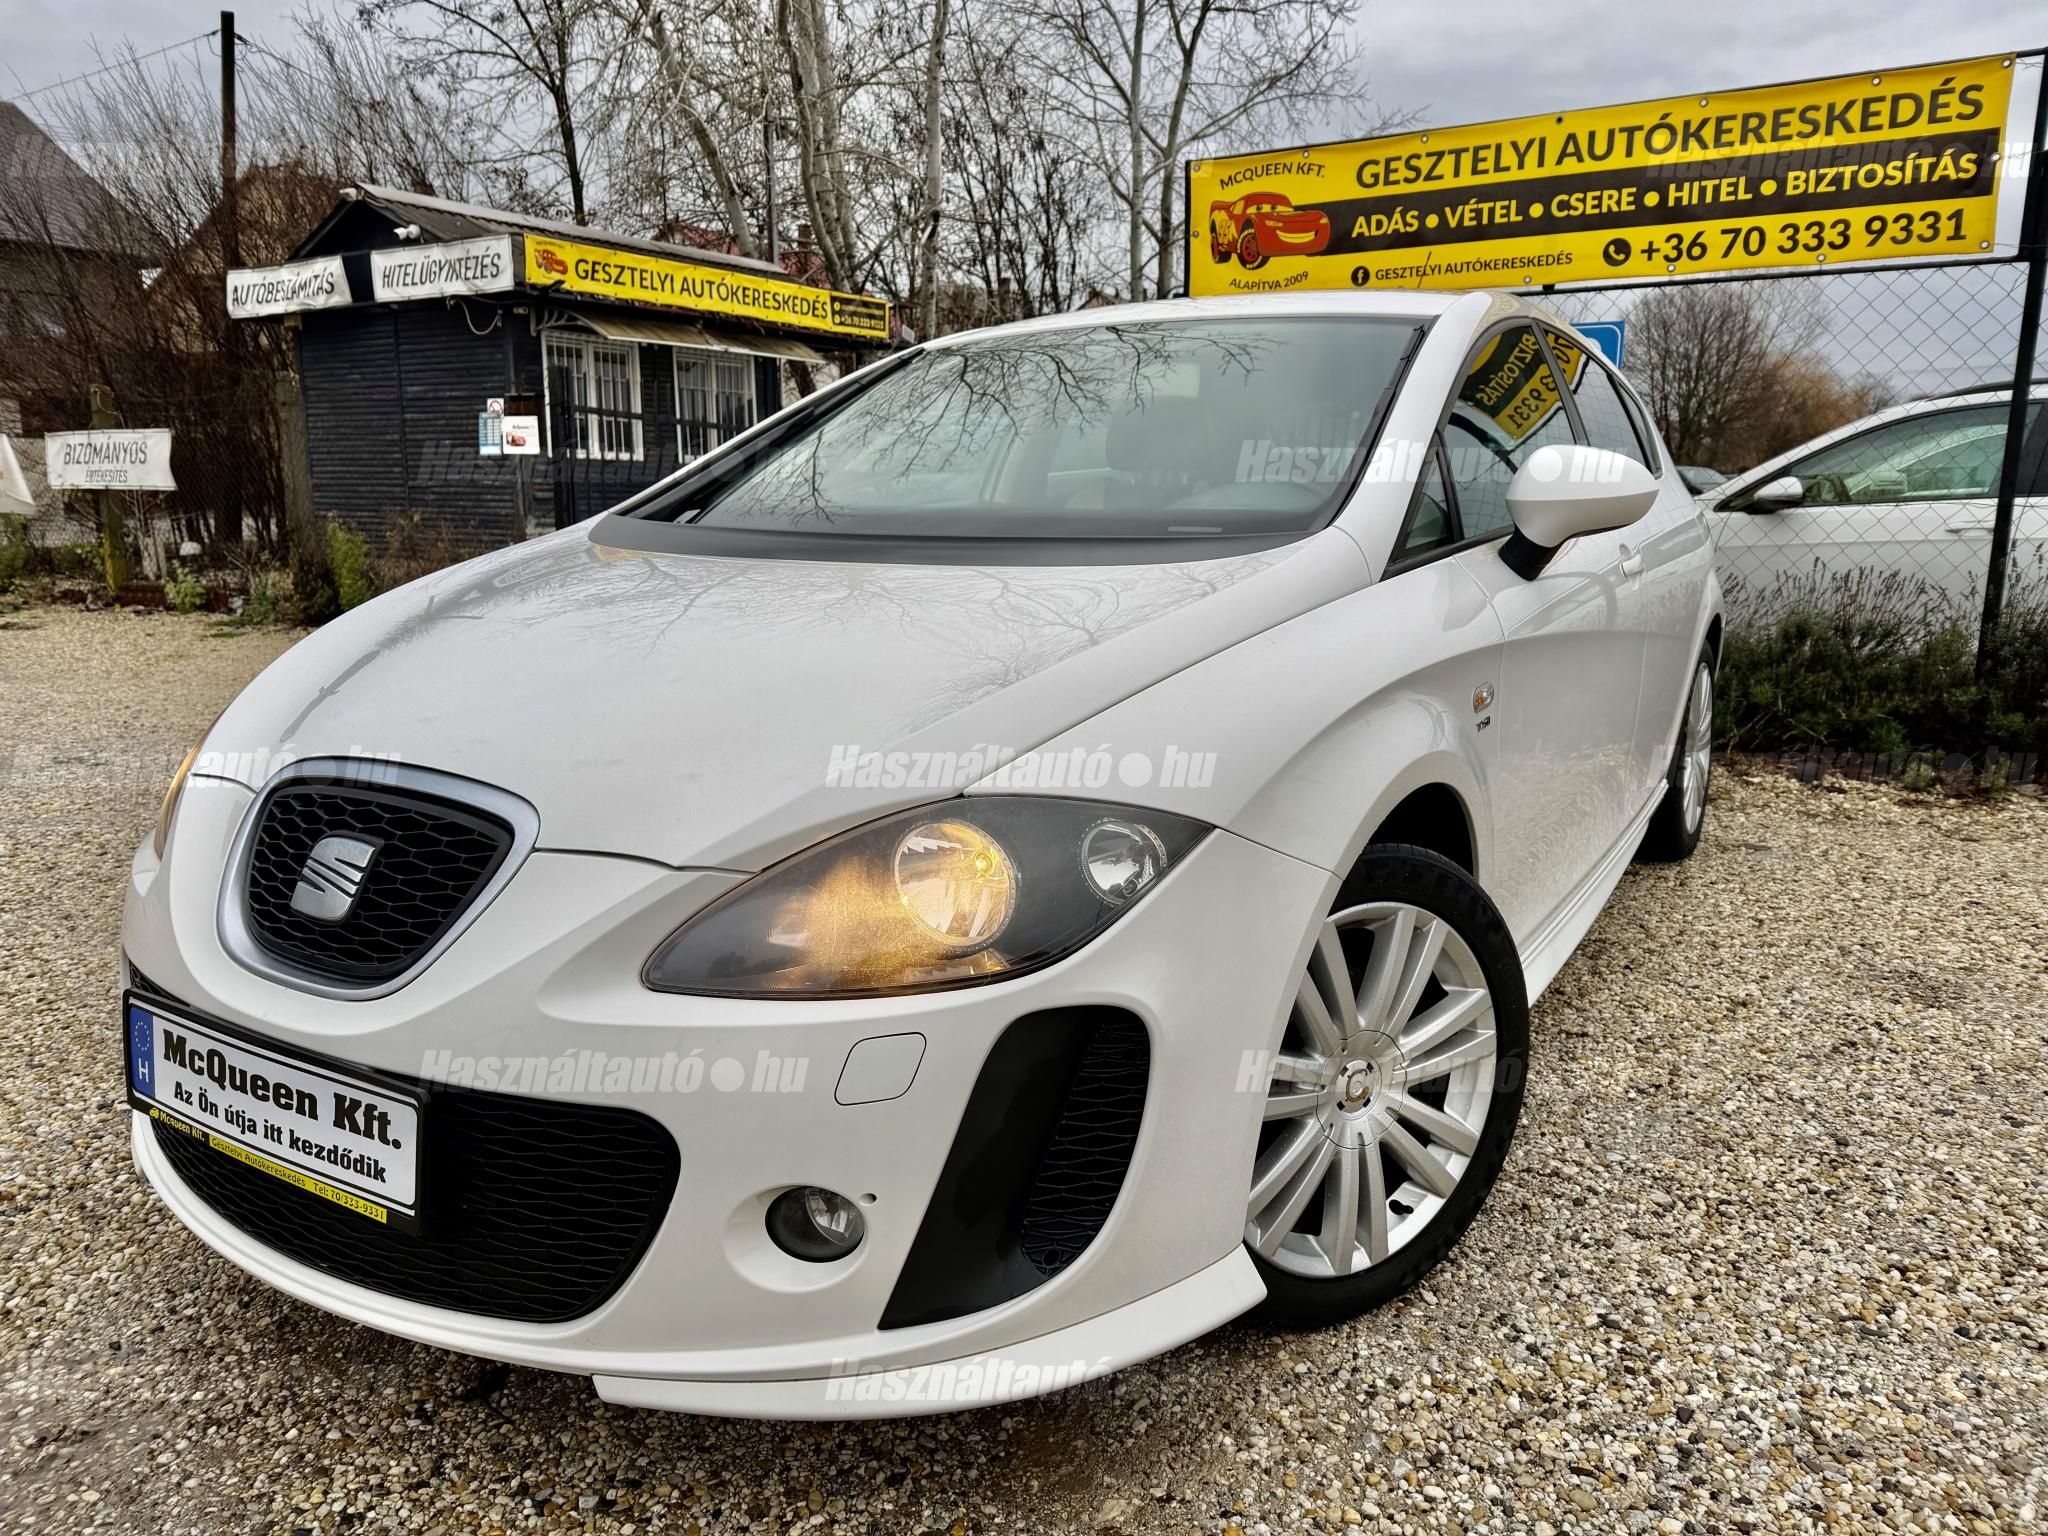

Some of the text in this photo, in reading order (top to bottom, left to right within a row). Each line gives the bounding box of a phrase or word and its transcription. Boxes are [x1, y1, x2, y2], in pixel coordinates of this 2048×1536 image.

[1356, 76, 1985, 189] GESZTELYI AUTÓKERESKEDÉS
[1219, 161, 1326, 191] MCQUEEN KFT.
[1351, 148, 1979, 239] ADÁS VÉTEL CSERE HITEL BIZTOSÍTÁS
[1639, 208, 1968, 263] +36 70 333 9331
[1229, 271, 1310, 291] ALAPÍTVA 2009
[1374, 250, 1574, 281] GESZTELYI AUTÓKERESKEDÉS
[231, 266, 336, 307] AUTÓBESZÁMÍTÁS
[574, 258, 829, 320] GESZTELYI AUTÓKERESKEDÉS
[63, 435, 148, 465] BIZOMÁNYOS
[85, 466, 129, 484] ÉRTÉKESÍTÉS
[137, 1057, 150, 1084] H
[162, 1028, 403, 1150] McQueen Kft.
[159, 1111, 192, 1138] Mcqueen
[173, 1080, 388, 1184] Az Ön útja itt kezdődik
[211, 1136, 384, 1221] Gesztelyi Autókereskedés Tel: 70/333-9331
